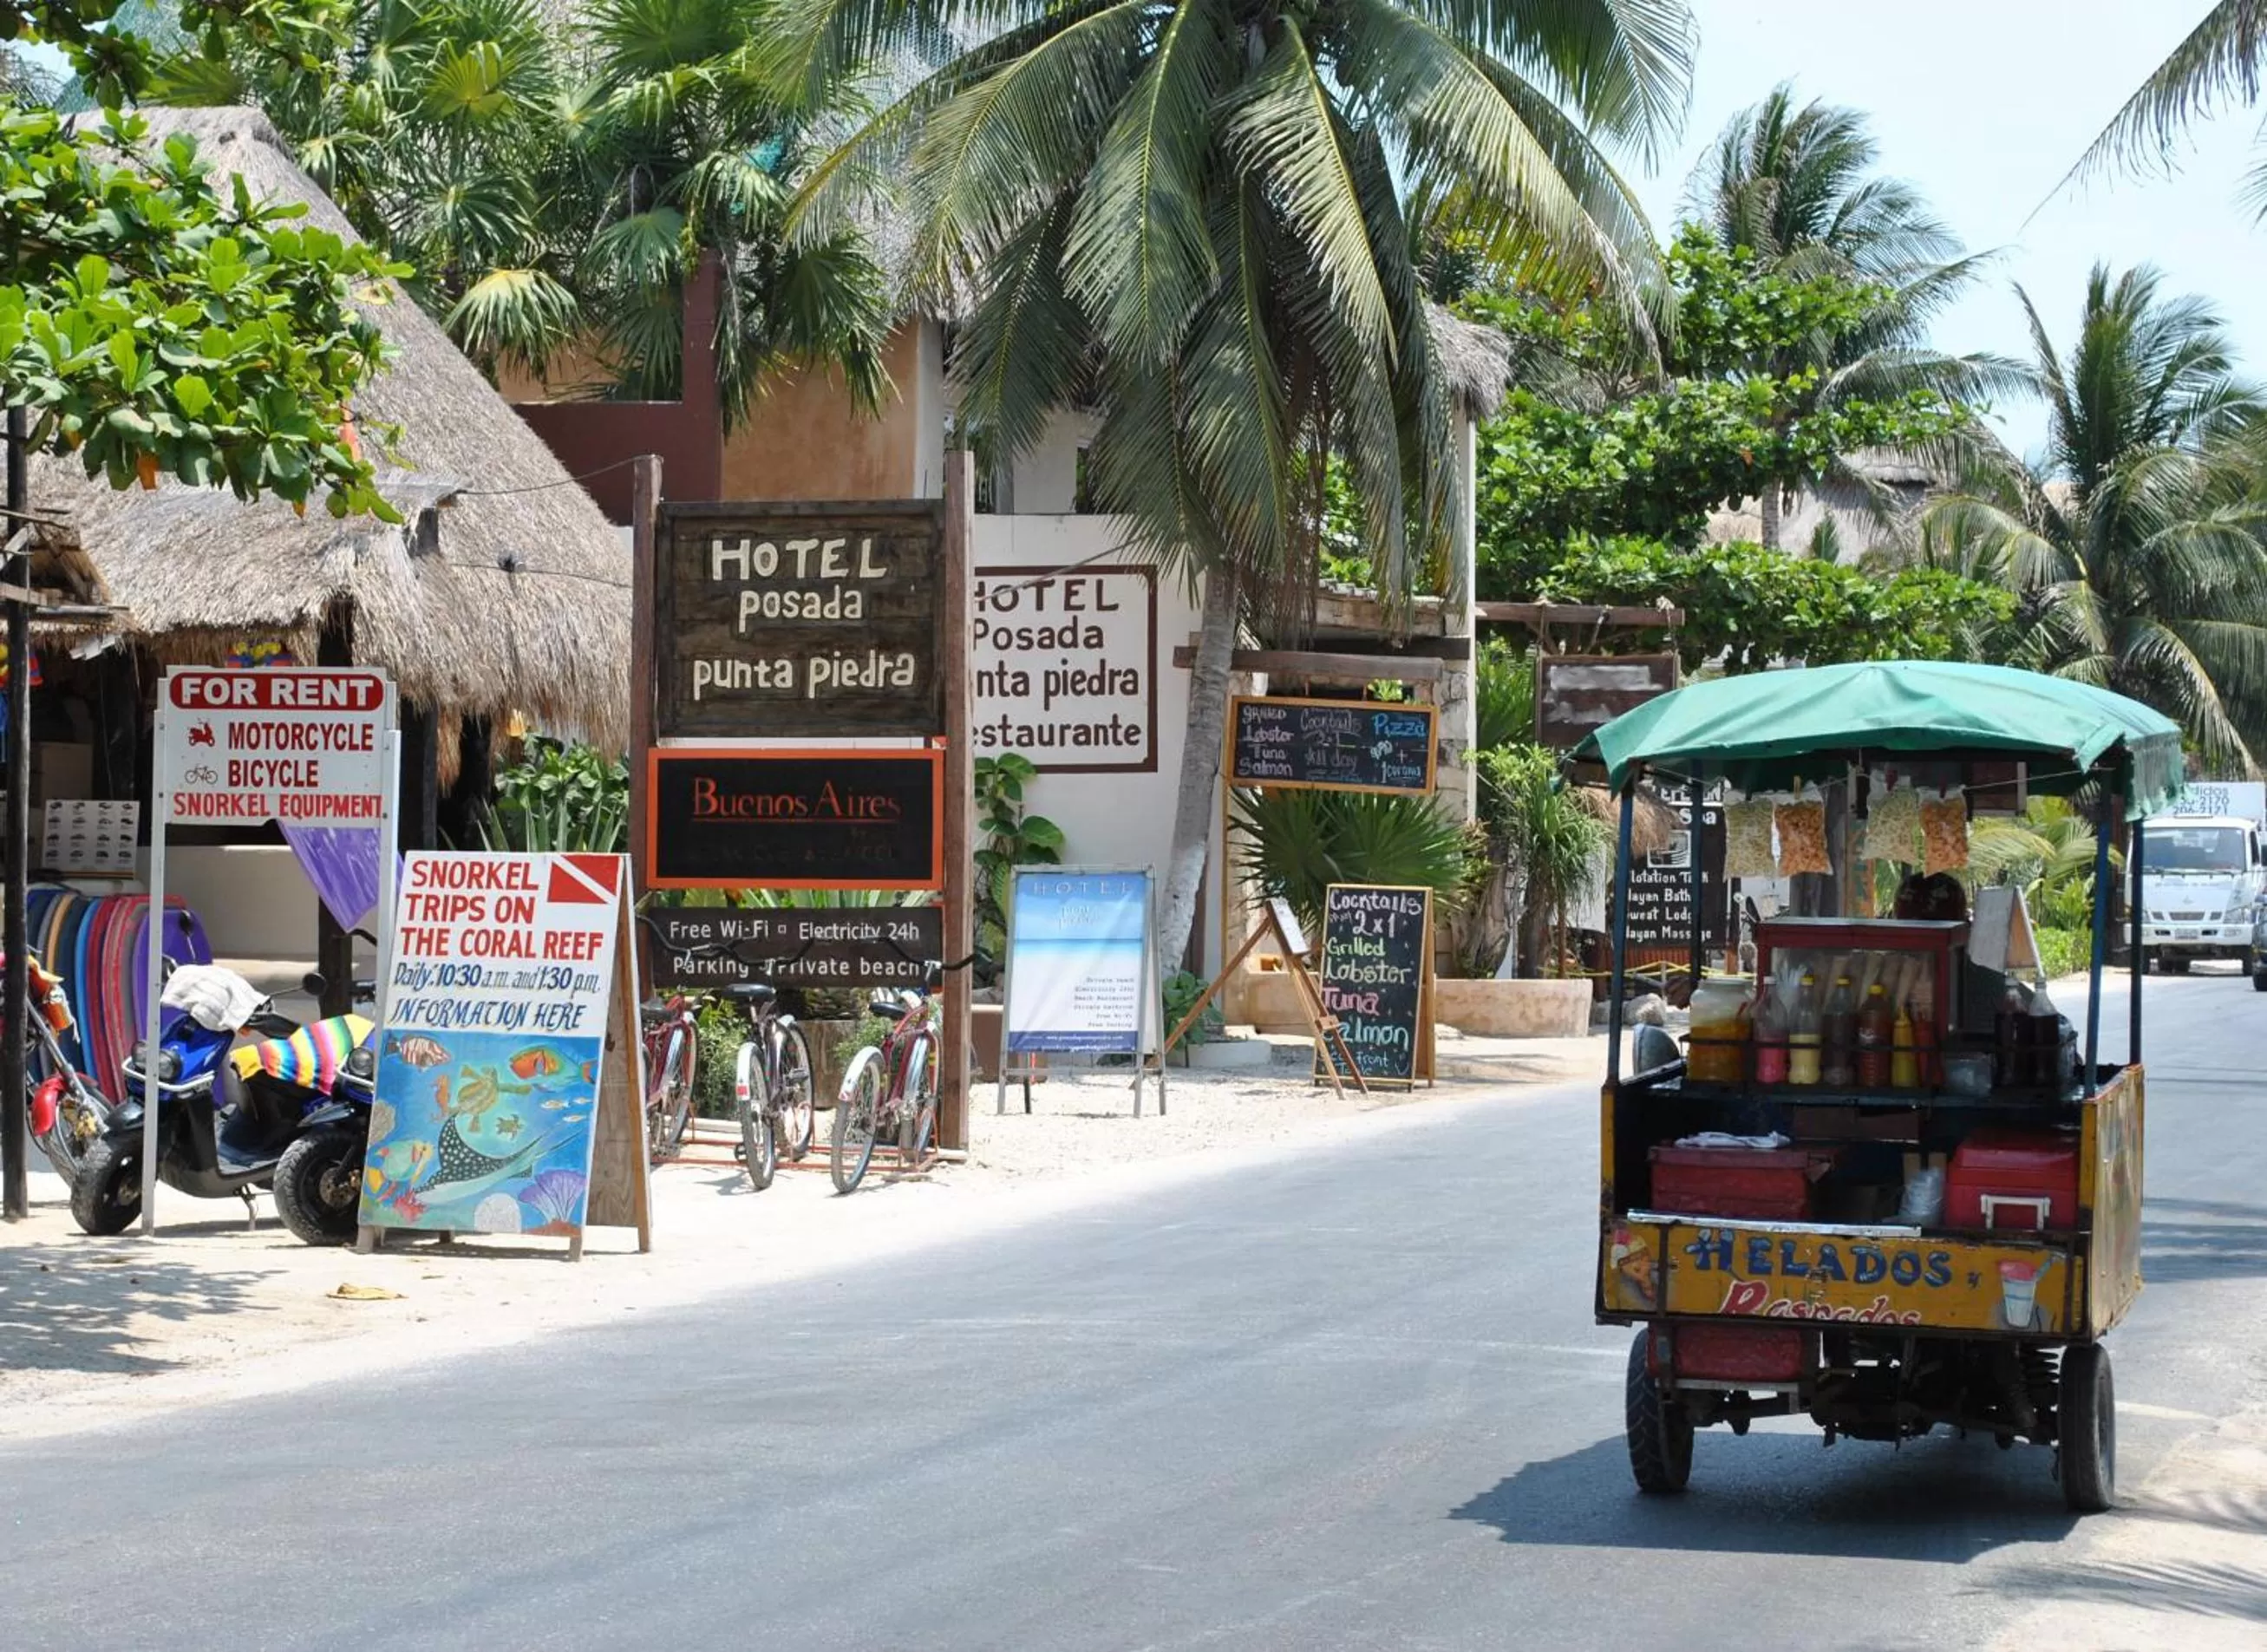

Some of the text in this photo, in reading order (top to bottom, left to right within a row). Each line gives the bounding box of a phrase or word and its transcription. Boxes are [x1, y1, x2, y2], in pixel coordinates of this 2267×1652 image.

[712, 538, 888, 580] HOTEL
[739, 584, 862, 633] posada
[694, 649, 915, 701] punta piedra
[977, 657, 1139, 712] nta piedra
[180, 677, 374, 707] FOR RENT
[228, 722, 374, 751] MOTORCYCLE
[973, 714, 1140, 748] staurante
[228, 760, 318, 787] BICYCLE
[173, 793, 382, 819] SNORKEL EQUIPMENT
[693, 777, 901, 818] Buenos Aires
[1679, 808, 1716, 825] Sa
[411, 860, 539, 891] SNORKEL
[1631, 870, 1676, 883] lotation
[406, 893, 536, 924] TRIPS ON
[1329, 890, 1422, 915] Cocktails
[1627, 906, 1659, 920] weat
[401, 927, 604, 961] THE CORAL REEF
[670, 919, 919, 941] Free Wi-Fi Electricity 24h
[1326, 936, 1386, 957] Grilled
[673, 957, 749, 978] Parking
[860, 957, 920, 976] beach
[1324, 958, 1411, 984] Lobster
[390, 997, 587, 1031] INFORMATION HERE
[1322, 987, 1380, 1016] Tuna
[1684, 1228, 1953, 1287] HELADOS
